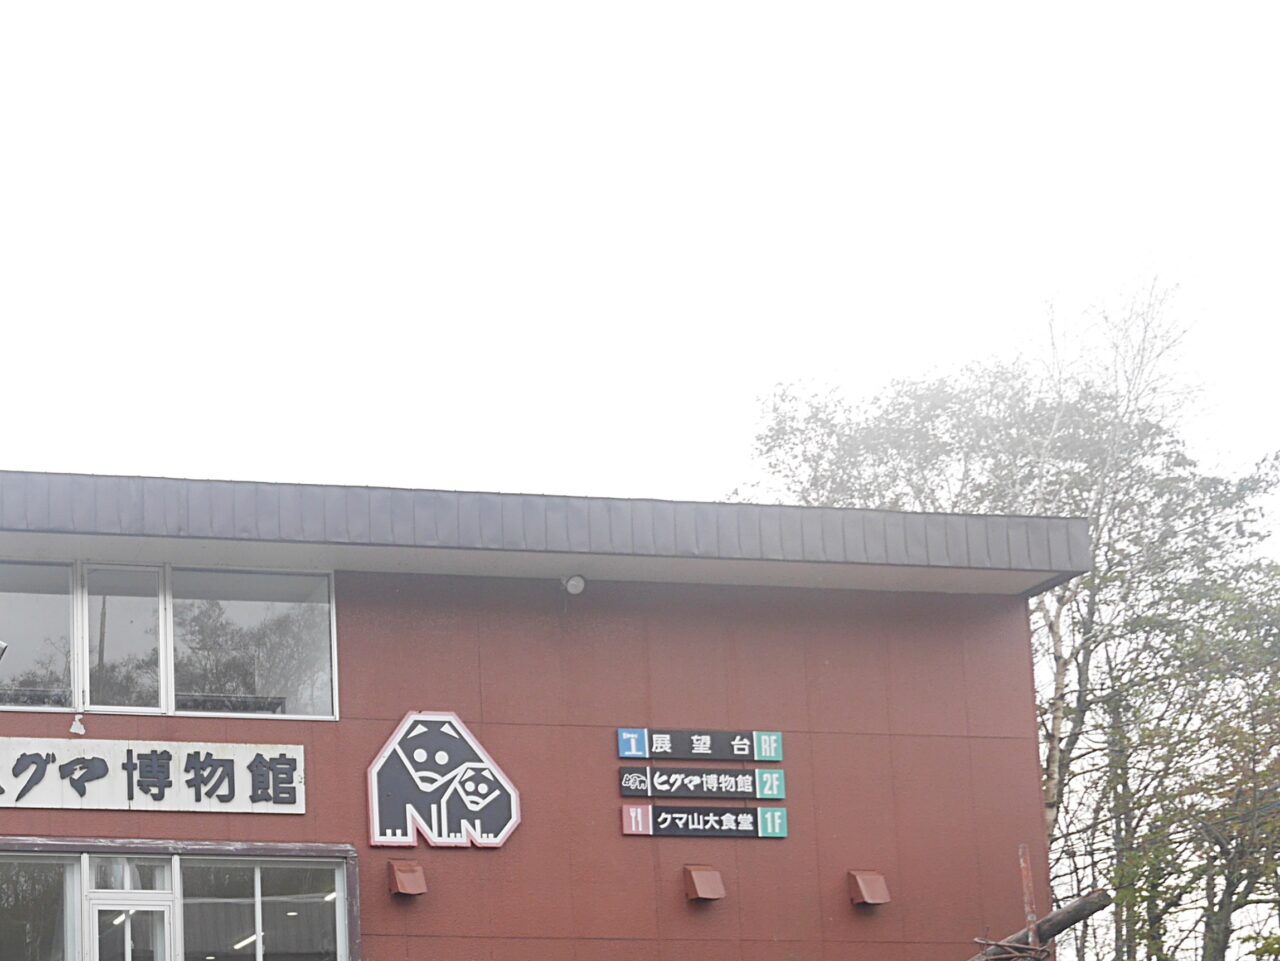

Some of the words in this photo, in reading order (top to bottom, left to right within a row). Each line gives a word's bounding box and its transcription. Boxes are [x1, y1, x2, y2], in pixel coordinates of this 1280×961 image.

[652, 734, 751, 755] 展望台
[761, 735, 777, 757] RF
[653, 771, 753, 792] ヒグマ博物館
[763, 773, 779, 795] 2F
[657, 812, 754, 831] クマ山大食堂
[764, 811, 782, 833] 1F
